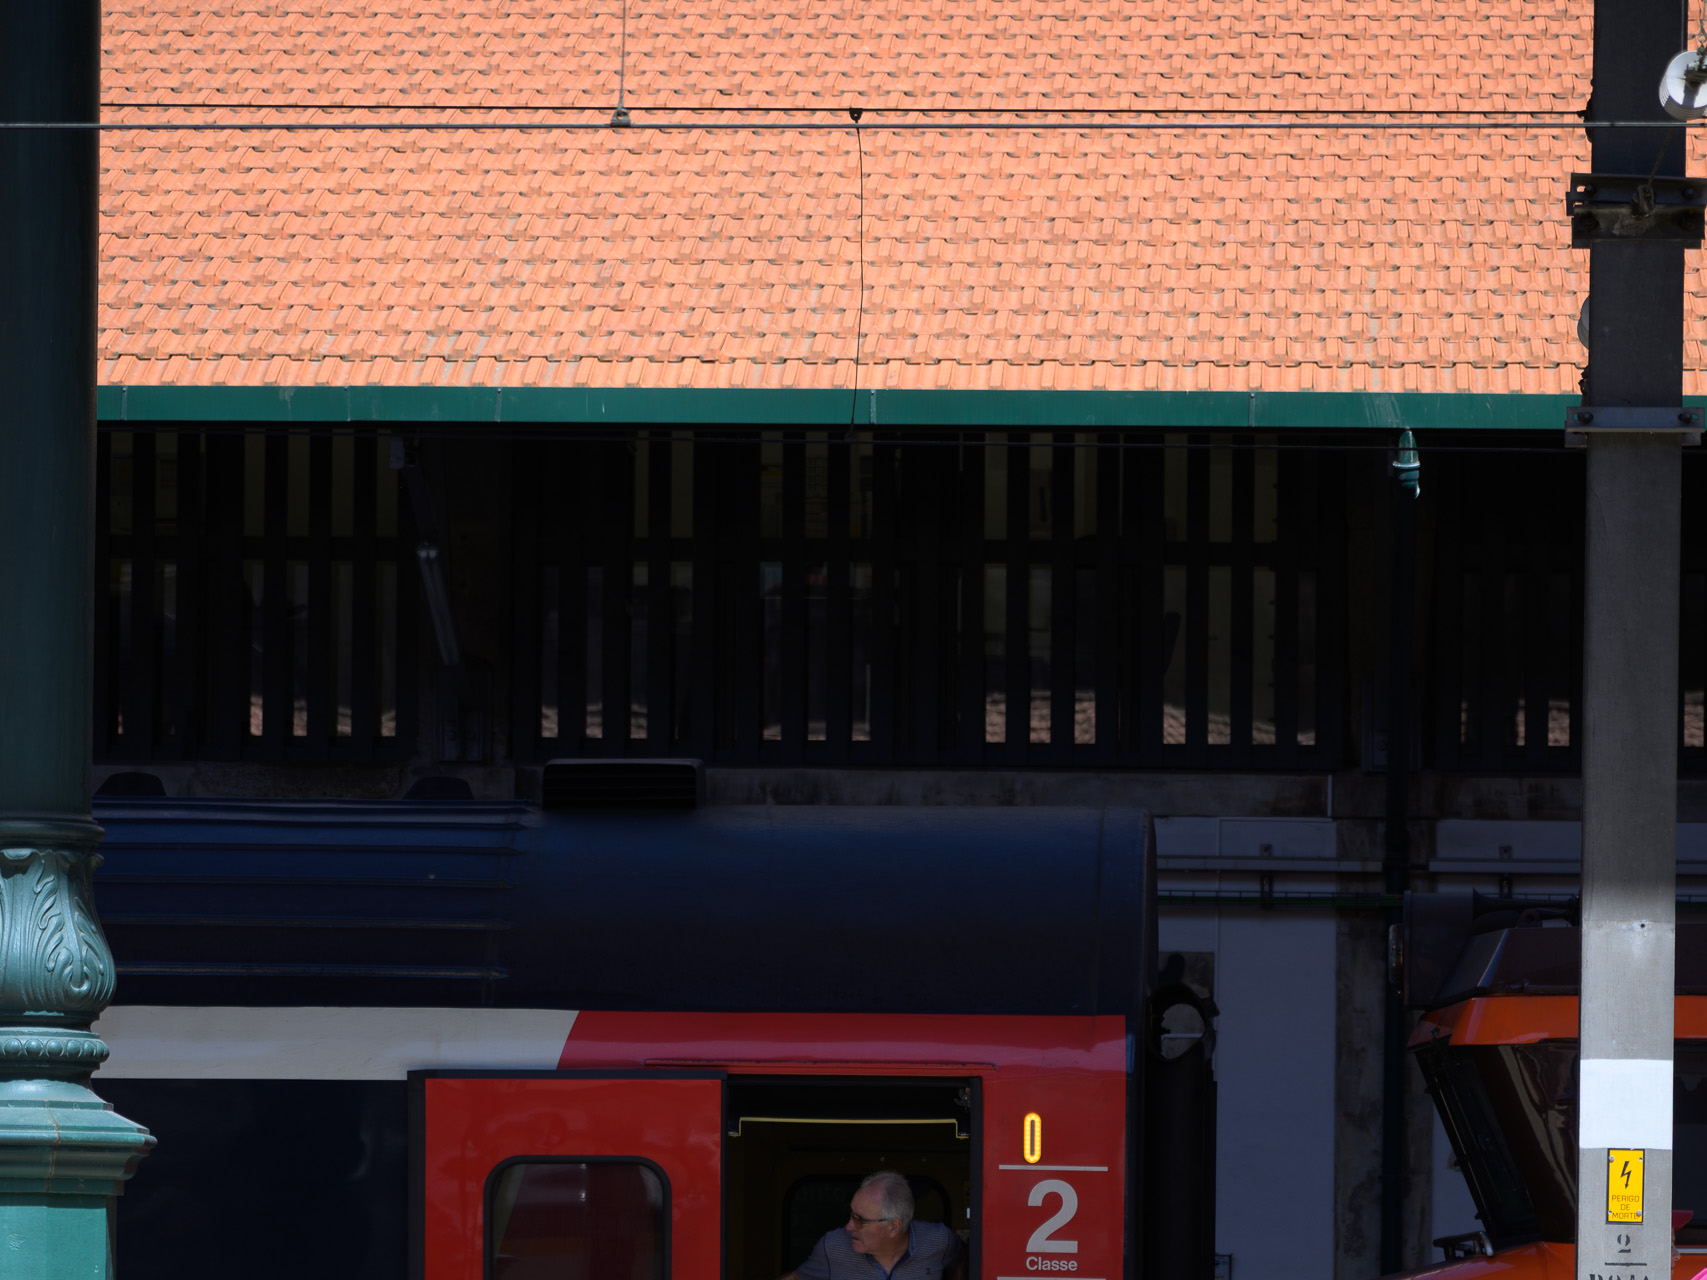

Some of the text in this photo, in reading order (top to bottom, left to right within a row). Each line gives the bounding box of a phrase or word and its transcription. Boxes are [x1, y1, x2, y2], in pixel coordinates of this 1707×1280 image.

[1611, 1194, 1640, 1203] PERIGO
[1620, 1203, 1630, 1211] DE
[1026, 1179, 1079, 1254] 2
[1617, 1234, 1631, 1253] 2
[1025, 1256, 1078, 1272] Classe
